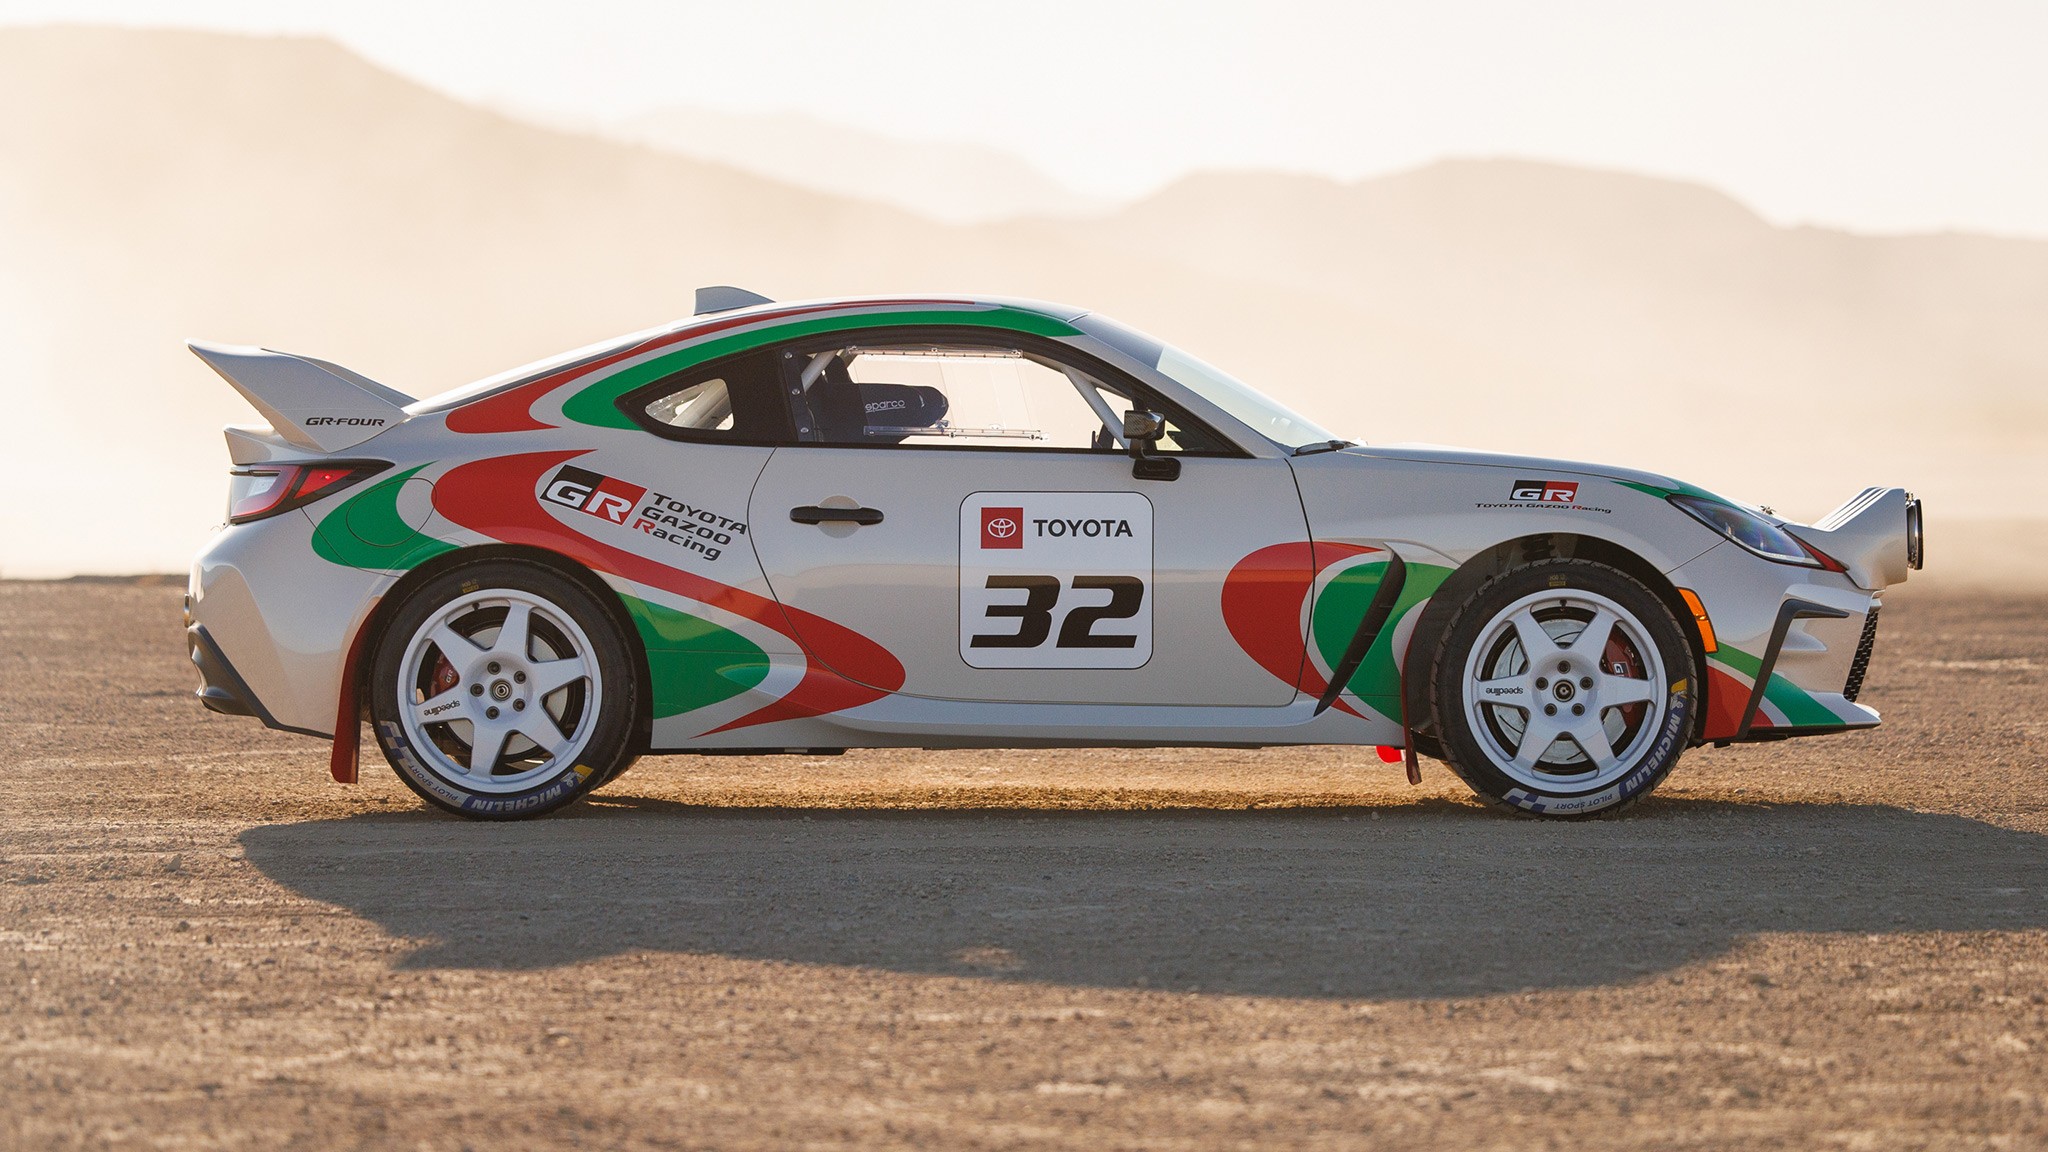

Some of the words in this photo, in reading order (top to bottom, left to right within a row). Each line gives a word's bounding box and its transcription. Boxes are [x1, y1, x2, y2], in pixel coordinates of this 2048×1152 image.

[865, 399, 906, 412] sparco
[546, 480, 633, 521] GR
[1512, 488, 1574, 501] GR
[653, 492, 747, 535] TOYOTA
[1572, 505, 1612, 514] Racing
[641, 506, 732, 545] GAZOO
[1033, 519, 1133, 537] TOYOTA
[633, 518, 722, 561] Racing
[970, 575, 1144, 648] 32
[1485, 686, 1524, 696] speedline
[423, 699, 461, 717] speedline
[1626, 714, 1682, 793] MICHELIN
[408, 764, 434, 787] SPORT
[433, 785, 459, 801] PILOT
[471, 784, 562, 811] MICHELIN
[1587, 793, 1613, 807] PILOT
[1554, 801, 1586, 810] SPORT
